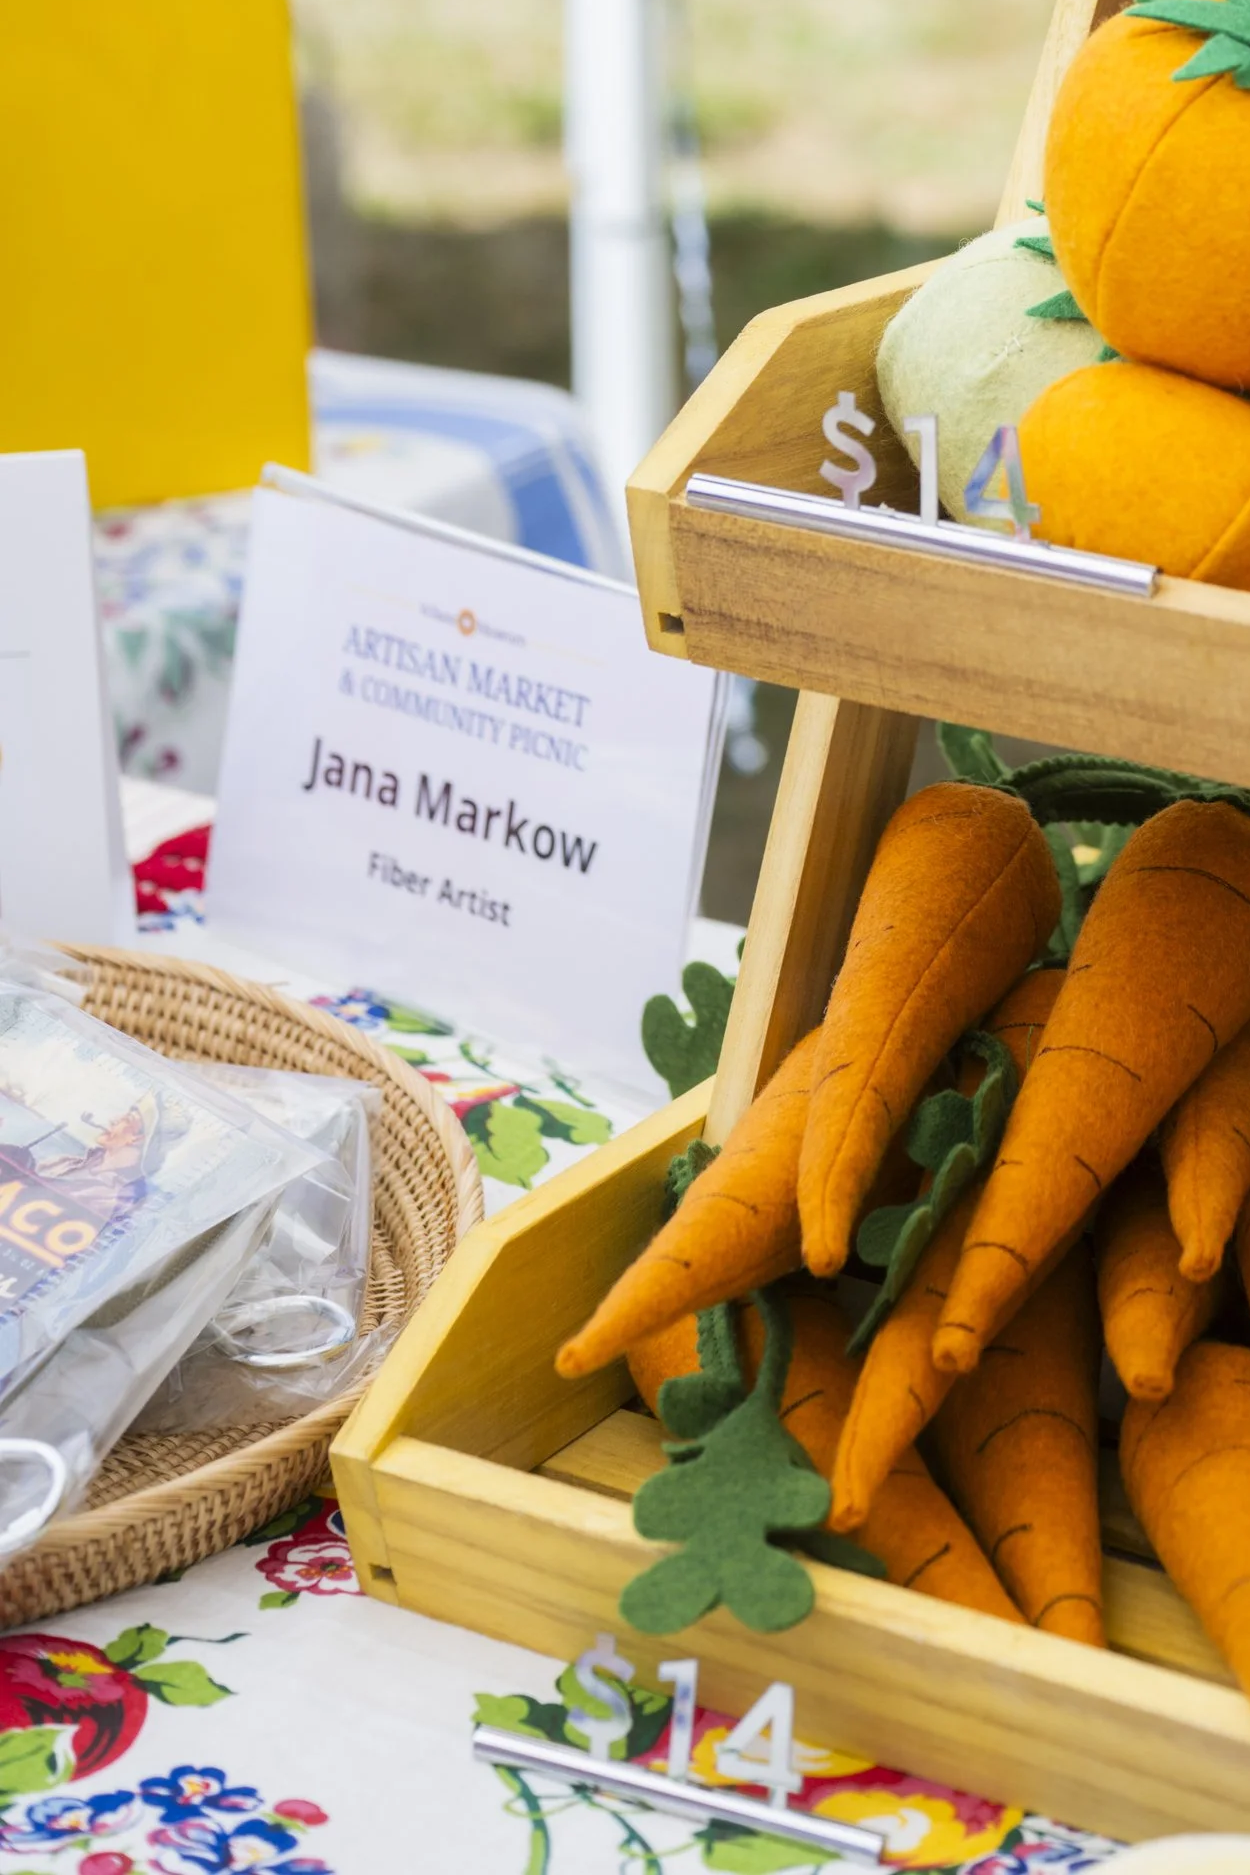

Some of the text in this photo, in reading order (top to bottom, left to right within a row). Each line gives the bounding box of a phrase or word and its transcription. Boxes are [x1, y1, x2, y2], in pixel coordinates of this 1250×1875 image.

[818, 390, 1042, 544] $14
[338, 666, 589, 773] & COMMUNITY PICNIC
[342, 625, 463, 688] ARTISAN
[466, 661, 592, 728] MARKET
[302, 736, 598, 874] Jana Markow
[367, 850, 513, 926] Fiber Artist
[566, 1633, 804, 1811] $14
